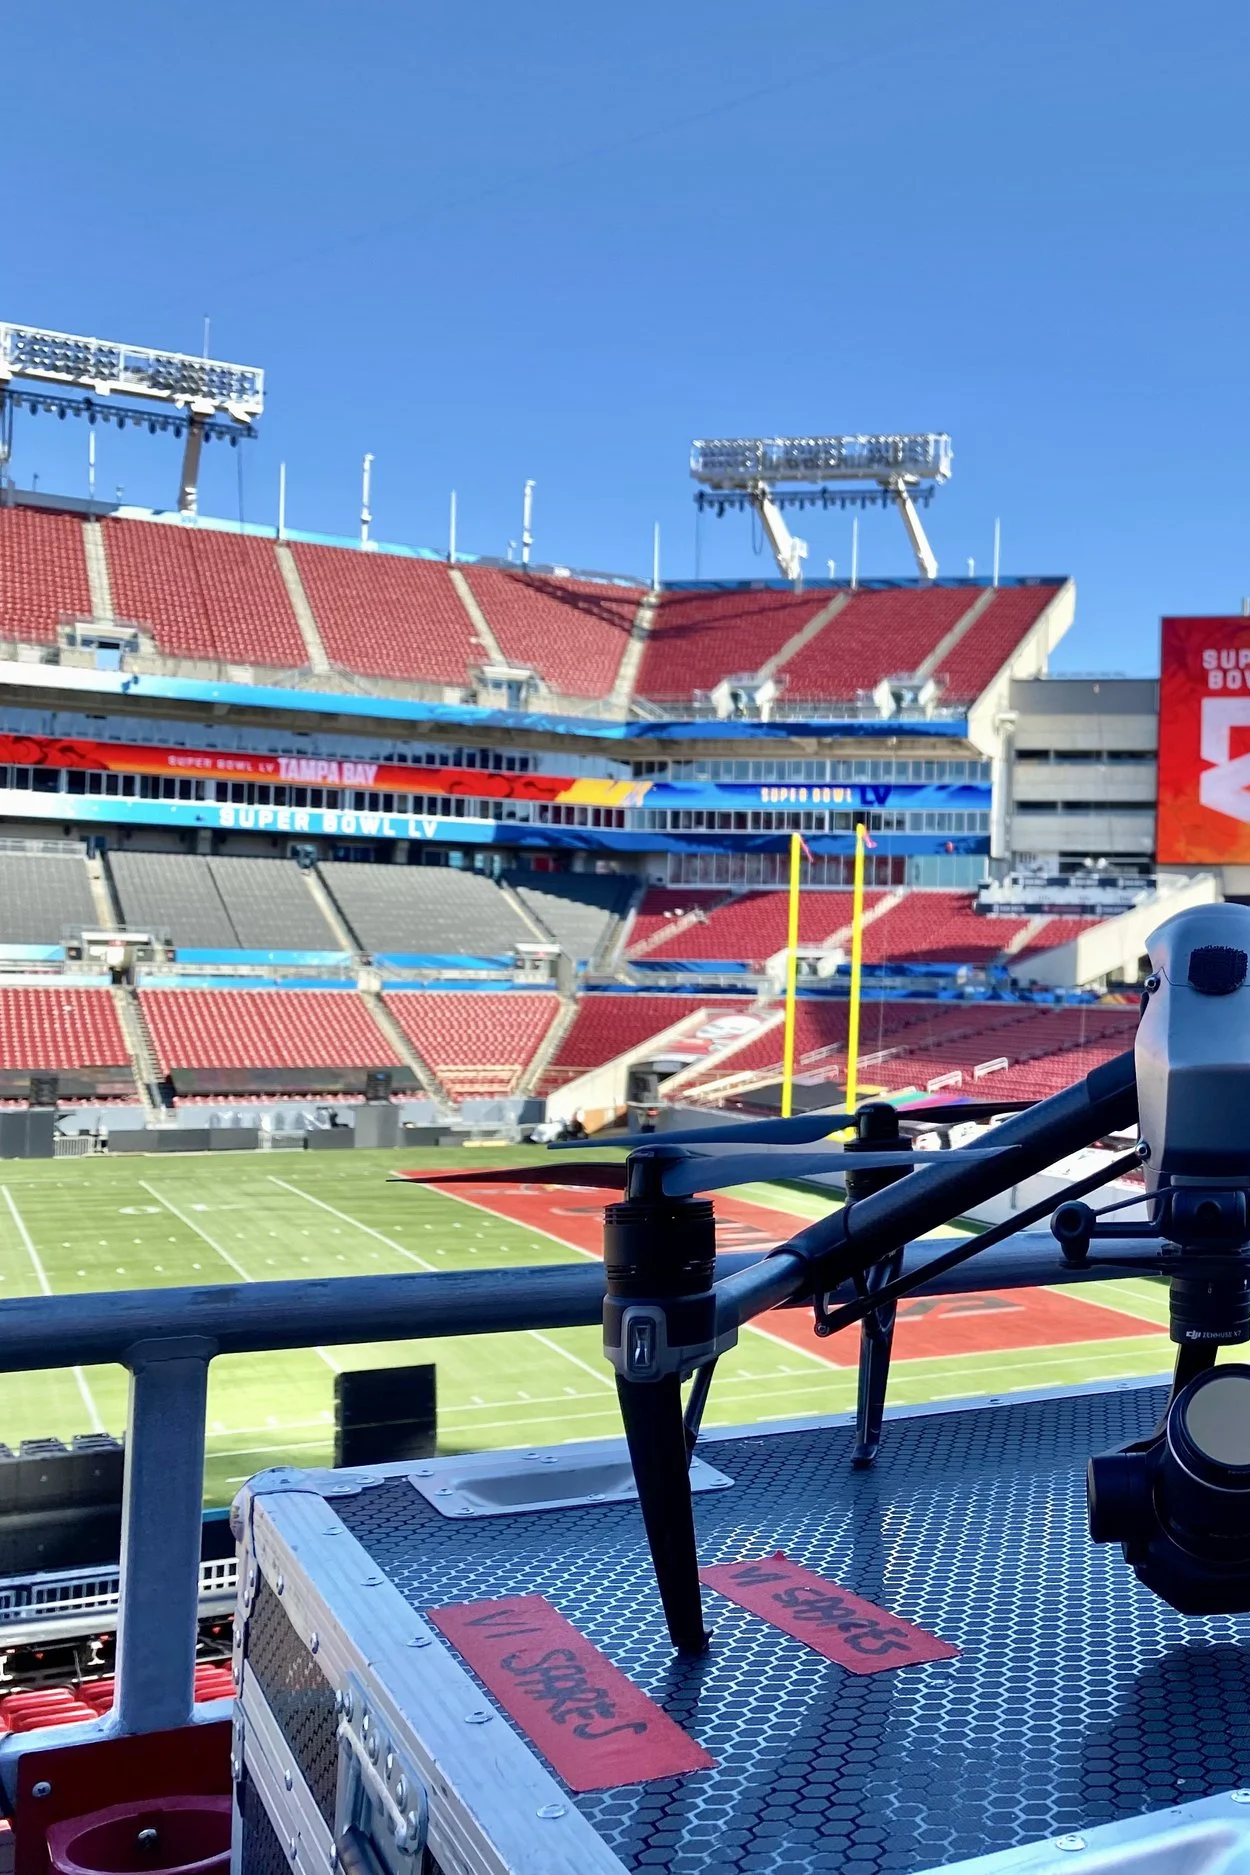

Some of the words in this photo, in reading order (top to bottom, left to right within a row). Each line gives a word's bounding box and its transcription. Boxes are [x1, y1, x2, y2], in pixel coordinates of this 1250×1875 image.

[167, 754, 212, 769] SUPER
[216, 757, 253, 772] BOWL
[258, 760, 274, 774] LV
[277, 757, 340, 783] TAMPA
[341, 761, 379, 786] BAY
[859, 784, 893, 807] LV
[219, 807, 312, 832] SUPER
[322, 813, 397, 837] BOWL
[407, 819, 438, 839] LV
[771, 1585, 912, 1657] SPARES
[500, 1648, 648, 1740] SPARES
